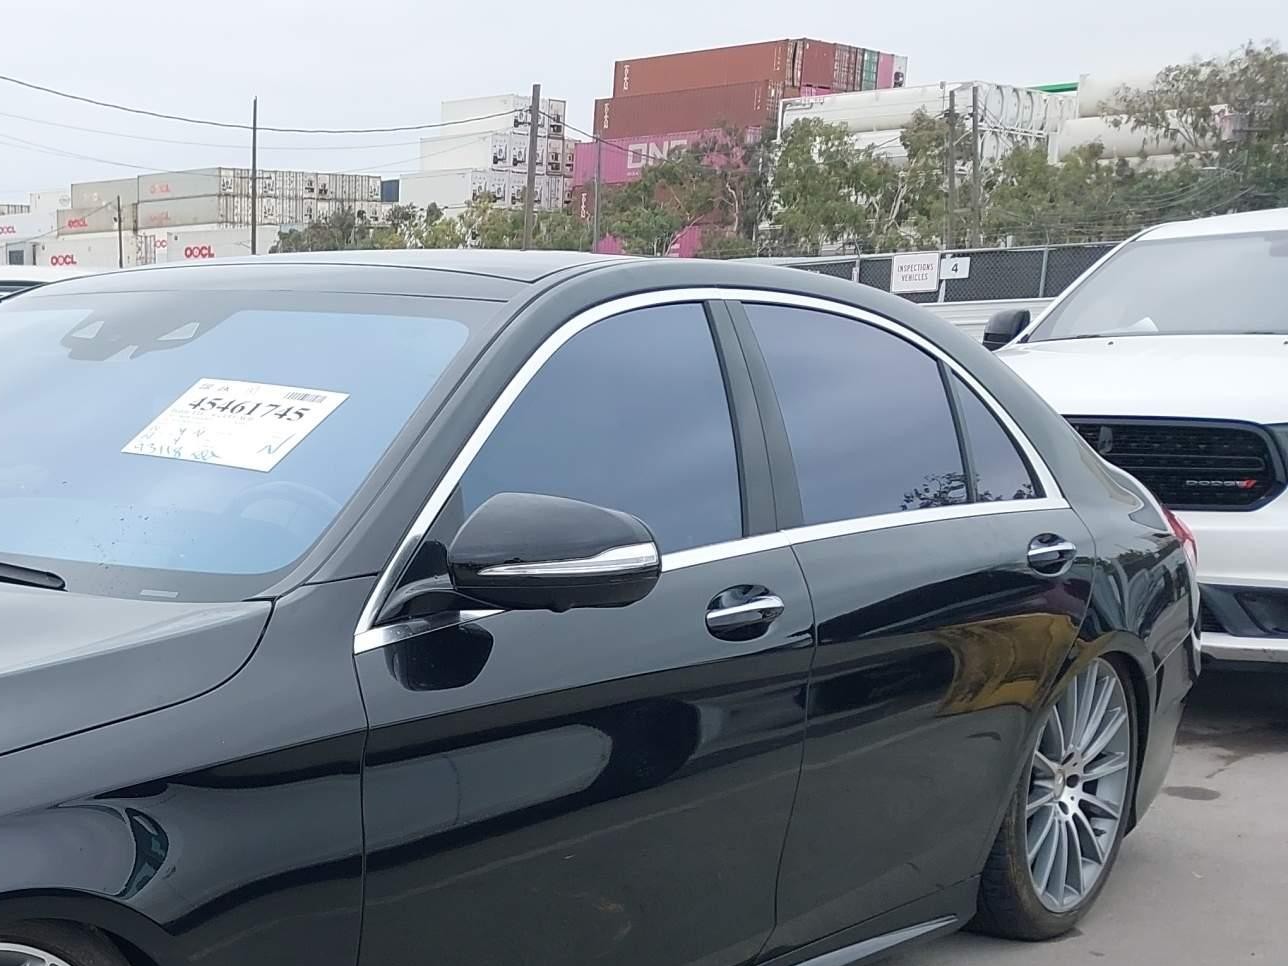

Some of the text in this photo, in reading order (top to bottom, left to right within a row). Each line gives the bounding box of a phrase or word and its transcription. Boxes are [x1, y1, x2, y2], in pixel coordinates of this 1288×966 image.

[184, 245, 215, 258] OOCL
[50, 254, 77, 266] OOCL
[897, 263, 934, 273] INSPECTIONS
[951, 262, 959, 273] 4
[901, 273, 929, 282] VEHICLES
[188, 396, 311, 422] 45461745
